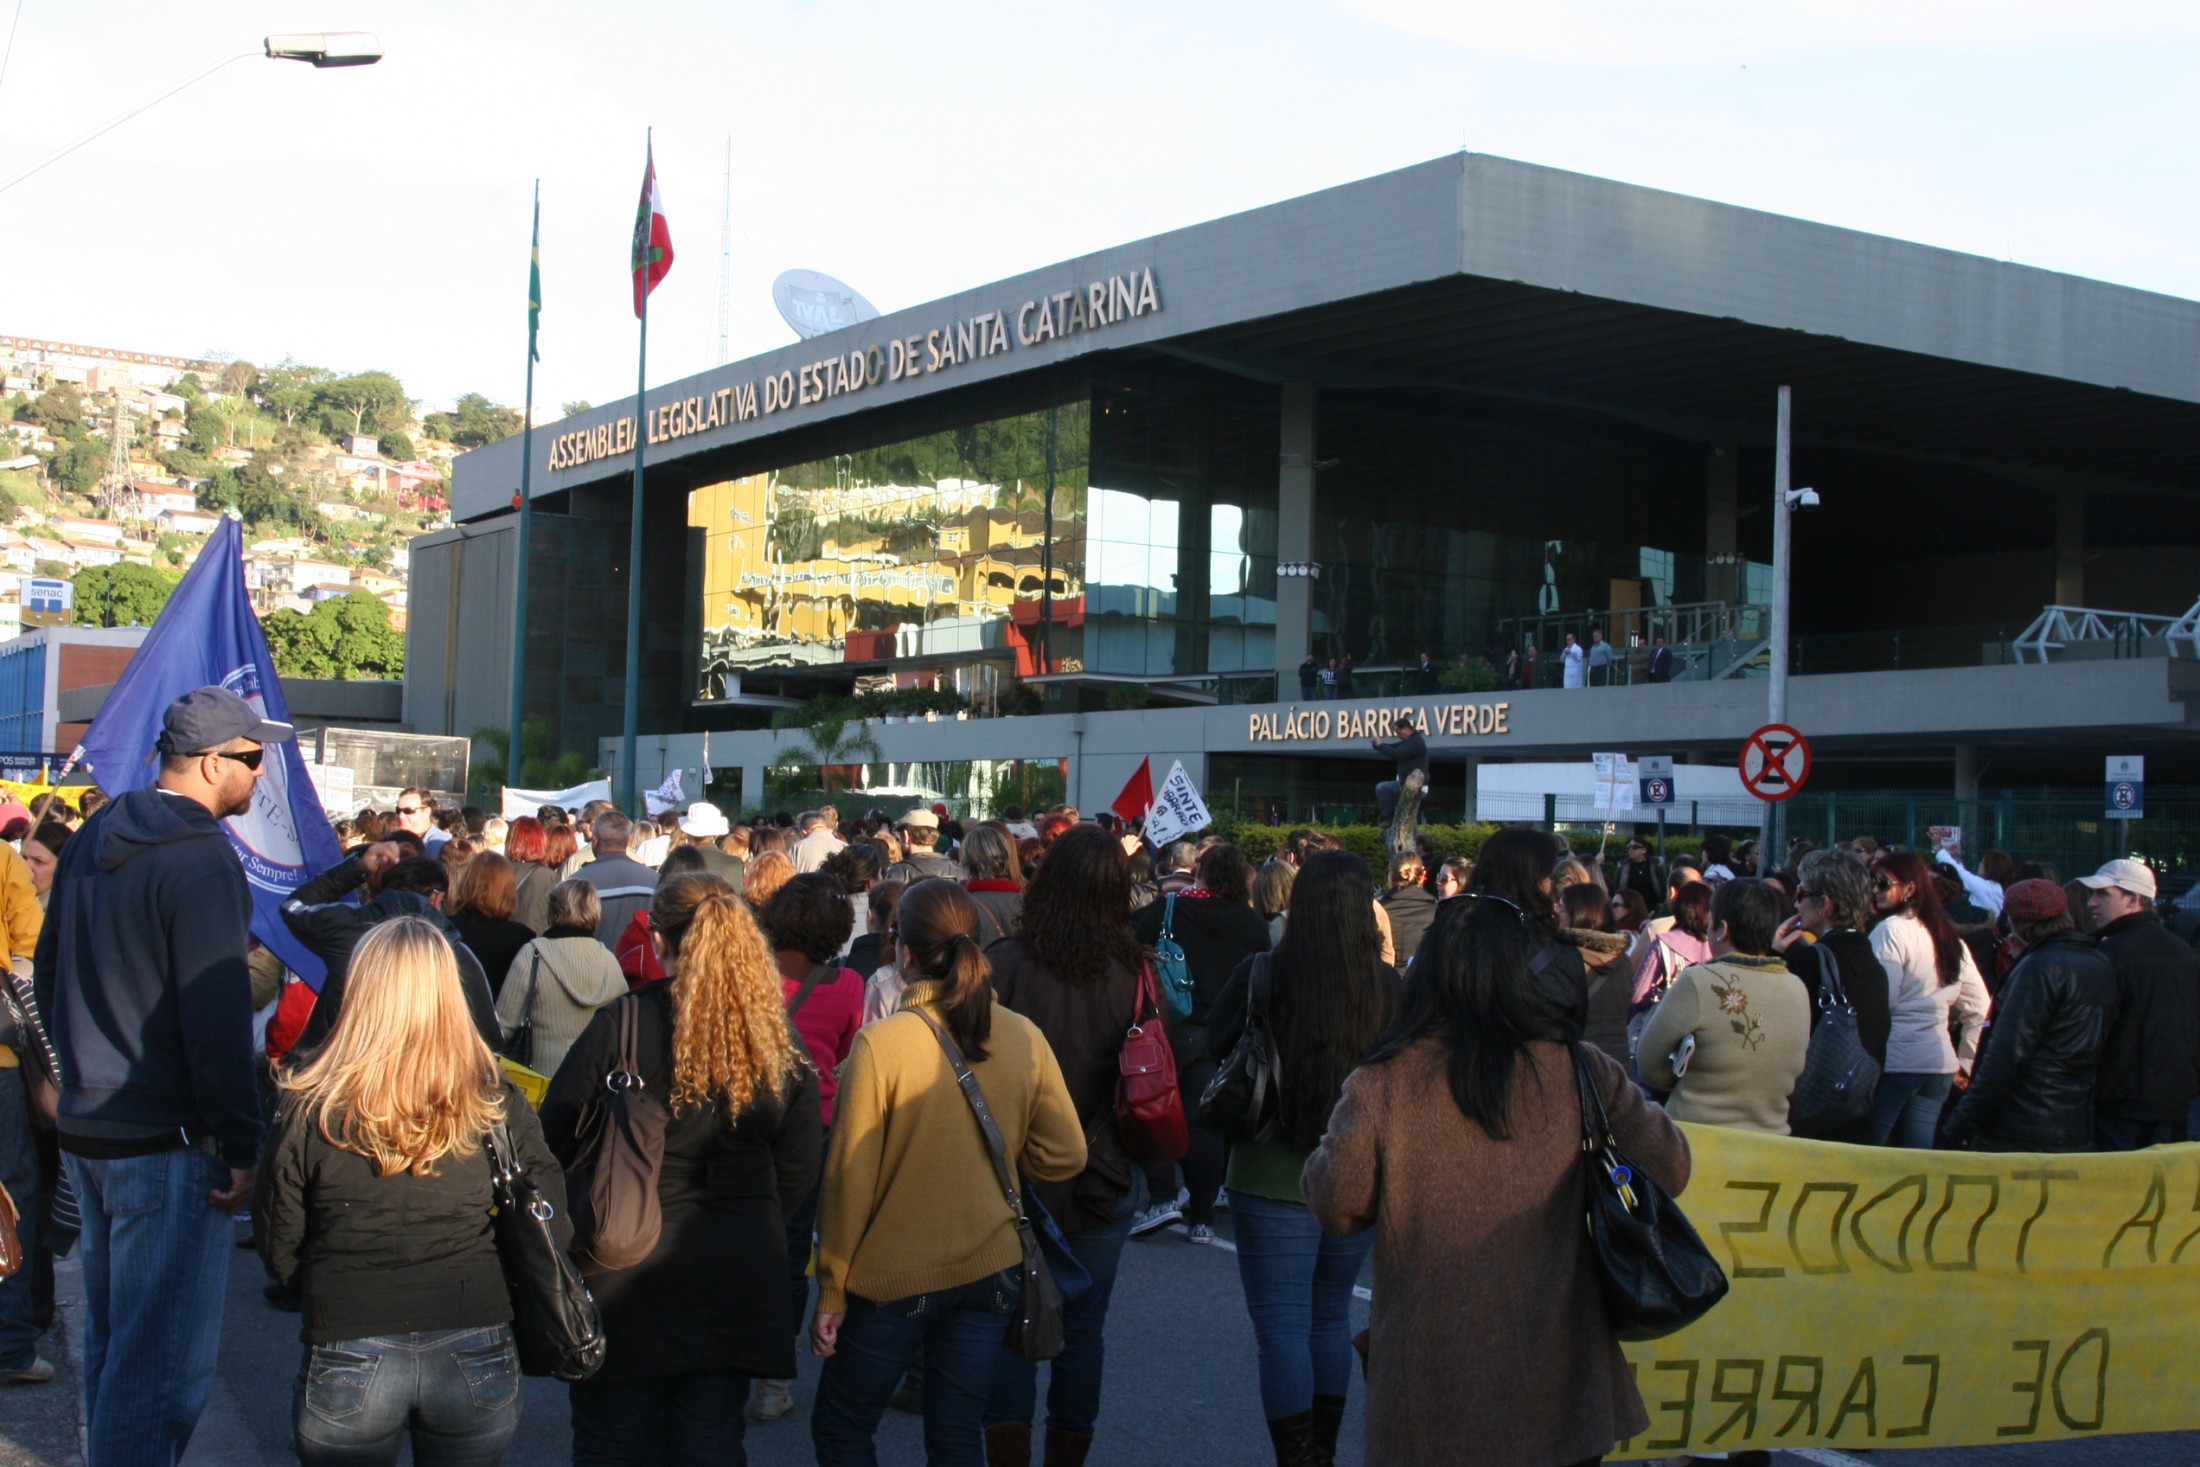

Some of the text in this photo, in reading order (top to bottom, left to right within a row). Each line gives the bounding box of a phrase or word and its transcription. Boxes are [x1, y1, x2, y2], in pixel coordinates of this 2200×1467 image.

[648, 381, 758, 444] LEGISLATIVA
[764, 369, 796, 414] DO
[799, 344, 884, 405] ESTADO
[889, 334, 923, 381] DE
[926, 309, 1010, 373] SANTA
[1017, 266, 1160, 347] CATARINA
[31, 588, 64, 598] senac
[1249, 706, 1331, 741] PALÁCIO
[1434, 702, 1510, 735] VERDE
[1169, 775, 1203, 824] SINTE
[248, 855, 298, 883] Sempre!
